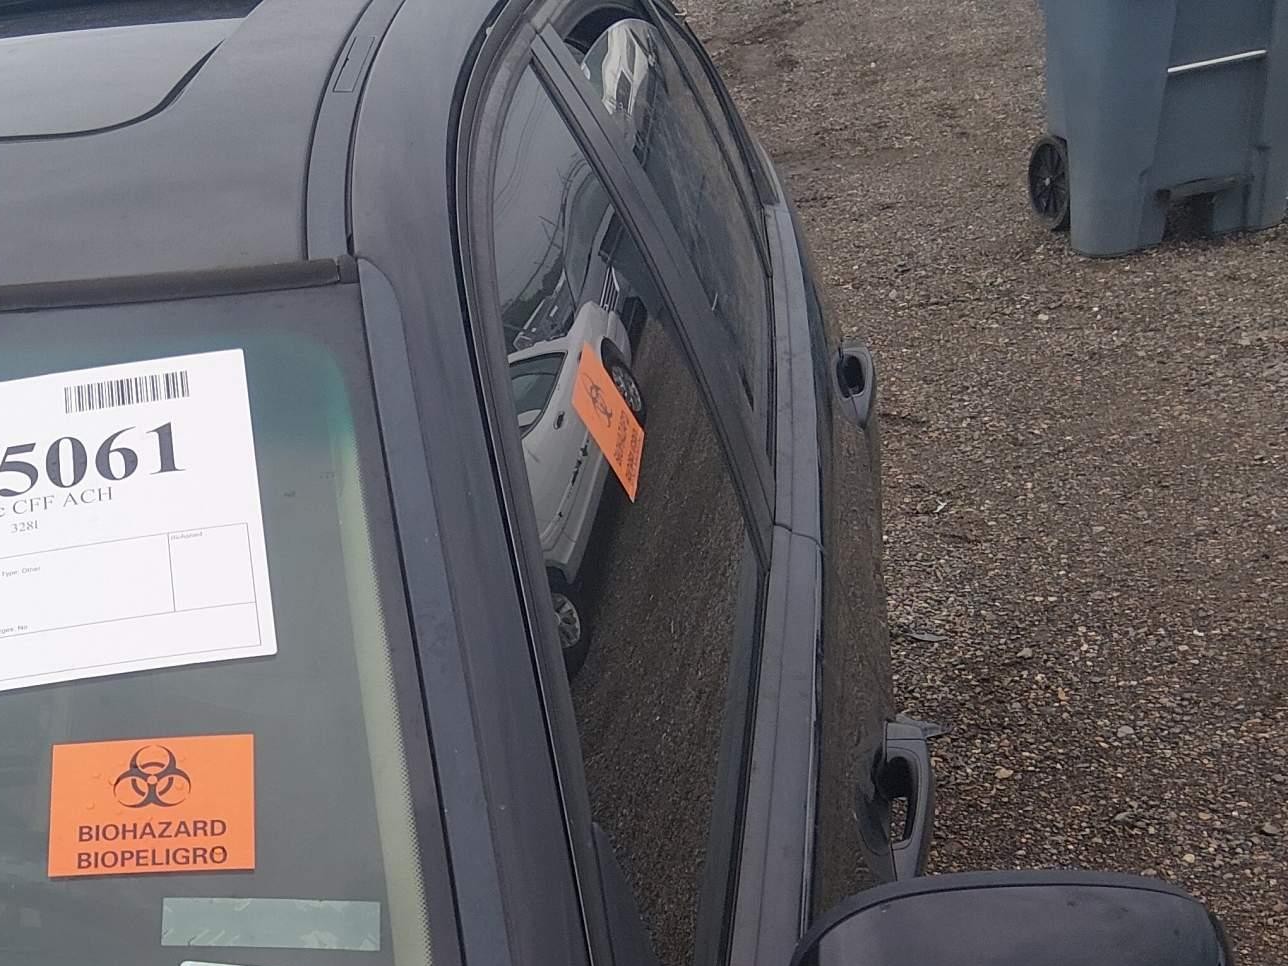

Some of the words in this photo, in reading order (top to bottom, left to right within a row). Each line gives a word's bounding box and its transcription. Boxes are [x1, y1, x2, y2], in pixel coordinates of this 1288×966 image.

[13, 493, 55, 515] CFF
[63, 486, 114, 507] ACH
[78, 819, 227, 842] BIOHAZARD
[77, 846, 228, 869] BIOPELIGRO
